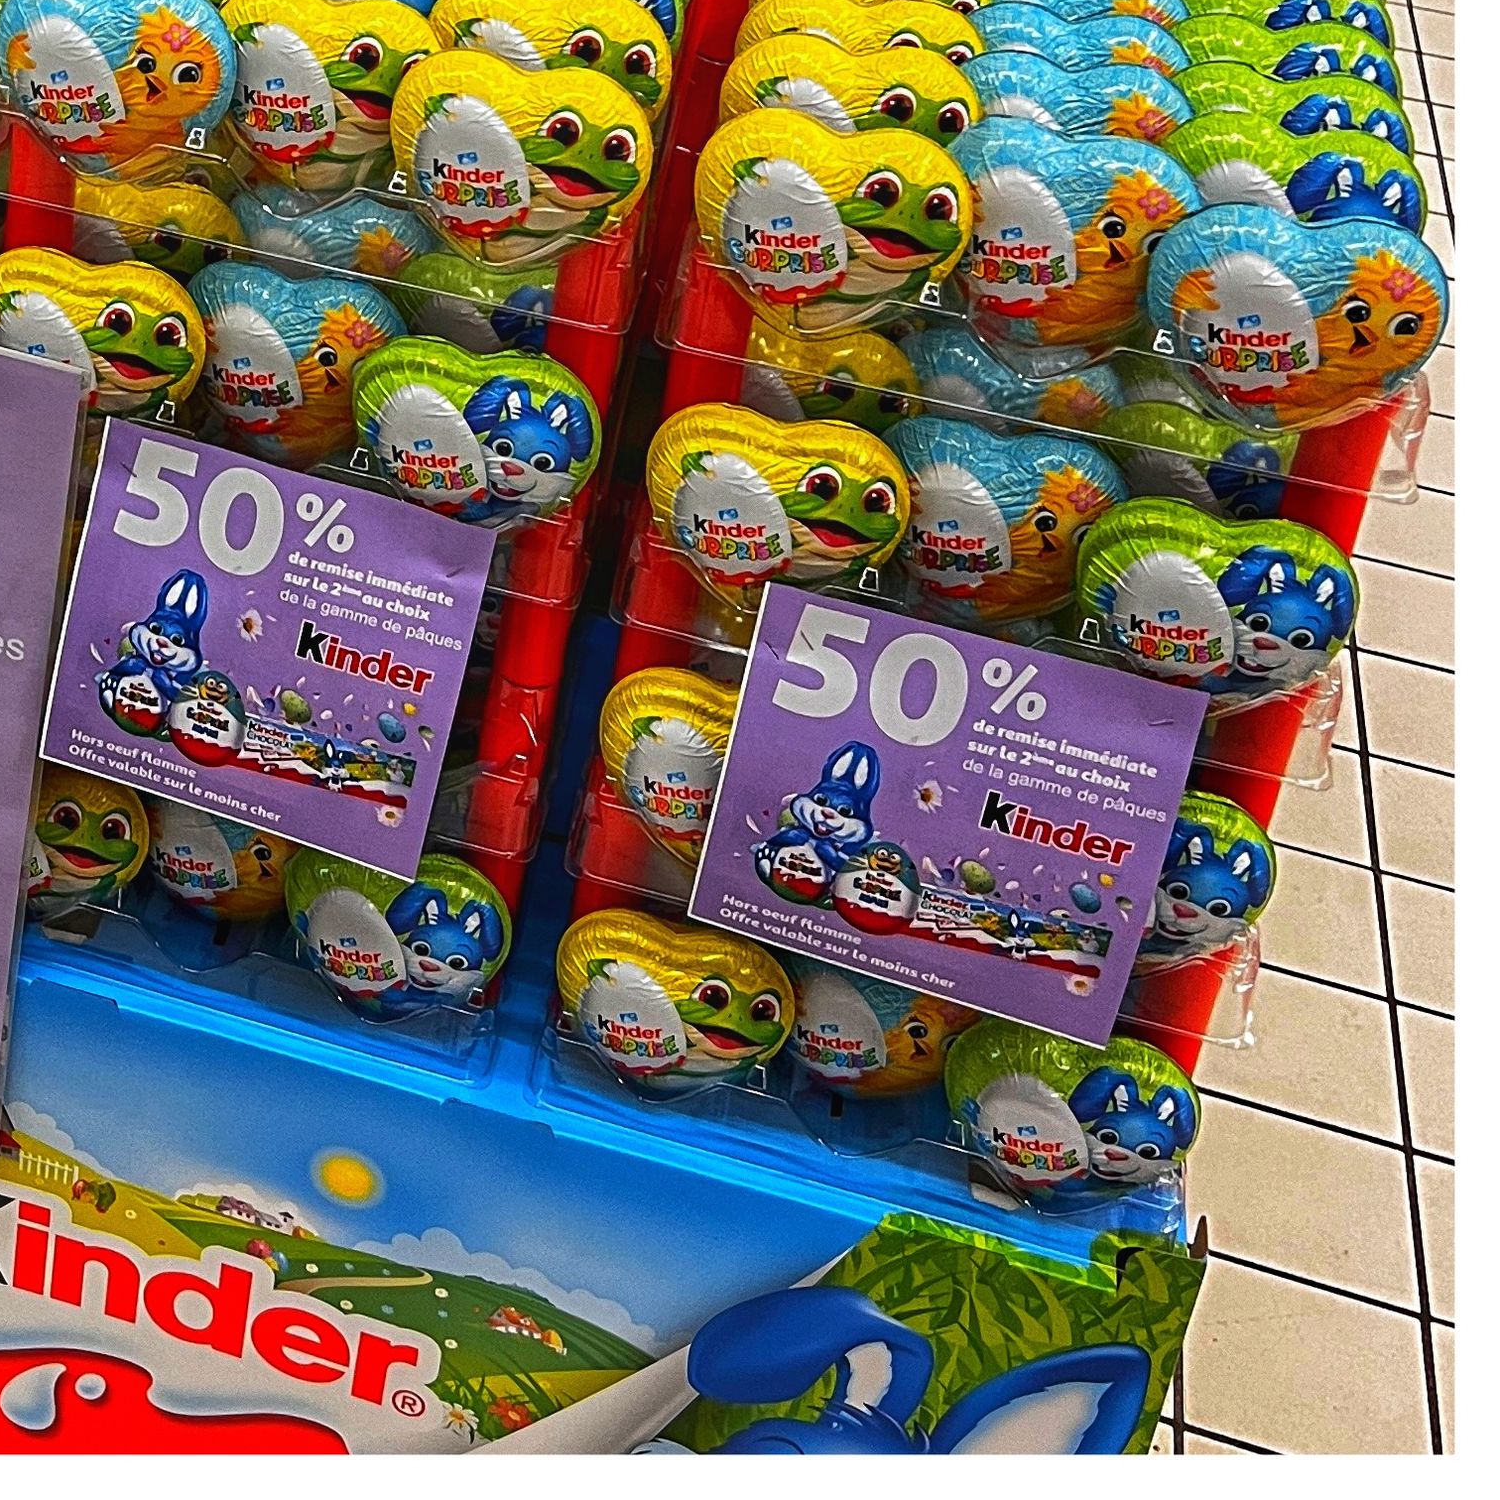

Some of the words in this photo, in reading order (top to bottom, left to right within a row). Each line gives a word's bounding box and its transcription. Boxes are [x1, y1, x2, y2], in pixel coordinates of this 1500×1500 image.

[31, 81, 94, 100] Kinder
[244, 86, 310, 109] Kinder
[433, 158, 504, 183] Kinder
[745, 225, 821, 249] Kinder
[972, 235, 1051, 260] Kinder
[1208, 323, 1291, 347] Kinder
[392, 445, 459, 468] Kinder
[113, 438, 355, 576] 50%
[693, 514, 766, 539] Kinder
[287, 551, 309, 567] de
[309, 558, 364, 583] remise
[365, 569, 455, 608] immédiate
[283, 572, 311, 588] sur
[312, 576, 329, 593] le
[361, 594, 384, 609] au
[384, 598, 431, 622] choix
[279, 588, 299, 604] de
[302, 593, 317, 610] la
[320, 602, 378, 628] gamme
[381, 618, 402, 634] de
[404, 625, 463, 651] pâques
[1130, 614, 1209, 641] Kinder
[296, 621, 432, 694] Kinder
[772, 603, 1047, 747] 50%
[71, 727, 103, 748] Hors
[106, 742, 139, 759] oeuf
[140, 750, 197, 778] flamme
[69, 743, 105, 765] Offre
[108, 758, 161, 783] valable
[162, 777, 187, 790] sur
[187, 781, 203, 796] le
[203, 790, 248, 812] moins
[249, 804, 282, 822] cher
[961, 758, 984, 774] de
[988, 763, 1004, 780] la
[1007, 772, 1073, 798] gamme
[1076, 788, 1099, 805] de
[1101, 797, 1168, 823] pâques
[980, 791, 1133, 864] Kinder
[598, 1015, 663, 1040] Kinder
[993, 1126, 1064, 1154] Kinder
